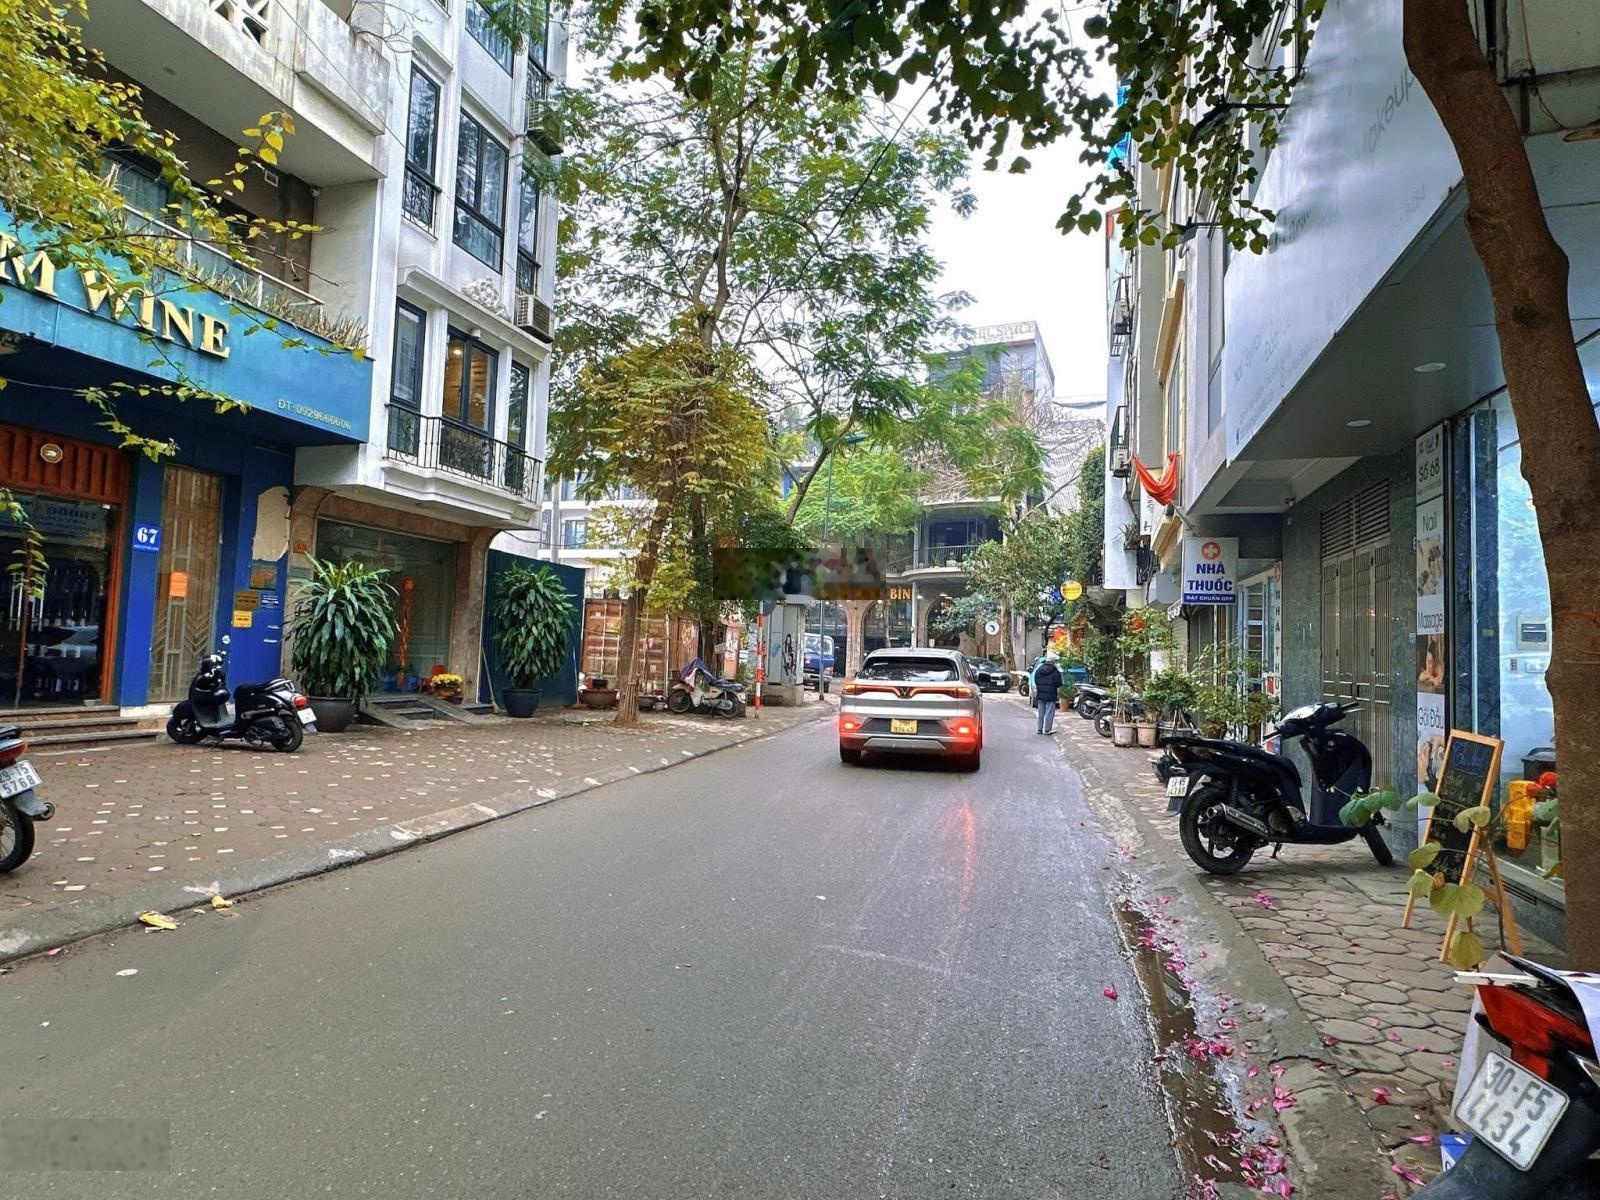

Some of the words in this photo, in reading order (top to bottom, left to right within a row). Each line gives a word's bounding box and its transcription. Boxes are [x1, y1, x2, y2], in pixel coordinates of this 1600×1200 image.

[80, 266, 231, 359] WINE
[1430, 457, 1440, 477] 68
[1422, 511, 1438, 533] Nail
[137, 527, 159, 544] 67
[1196, 561, 1226, 574] NHÀ
[1187, 576, 1233, 591] THUỐC
[1417, 611, 1444, 633] Massage
[2, 774, 35, 795] 5768
